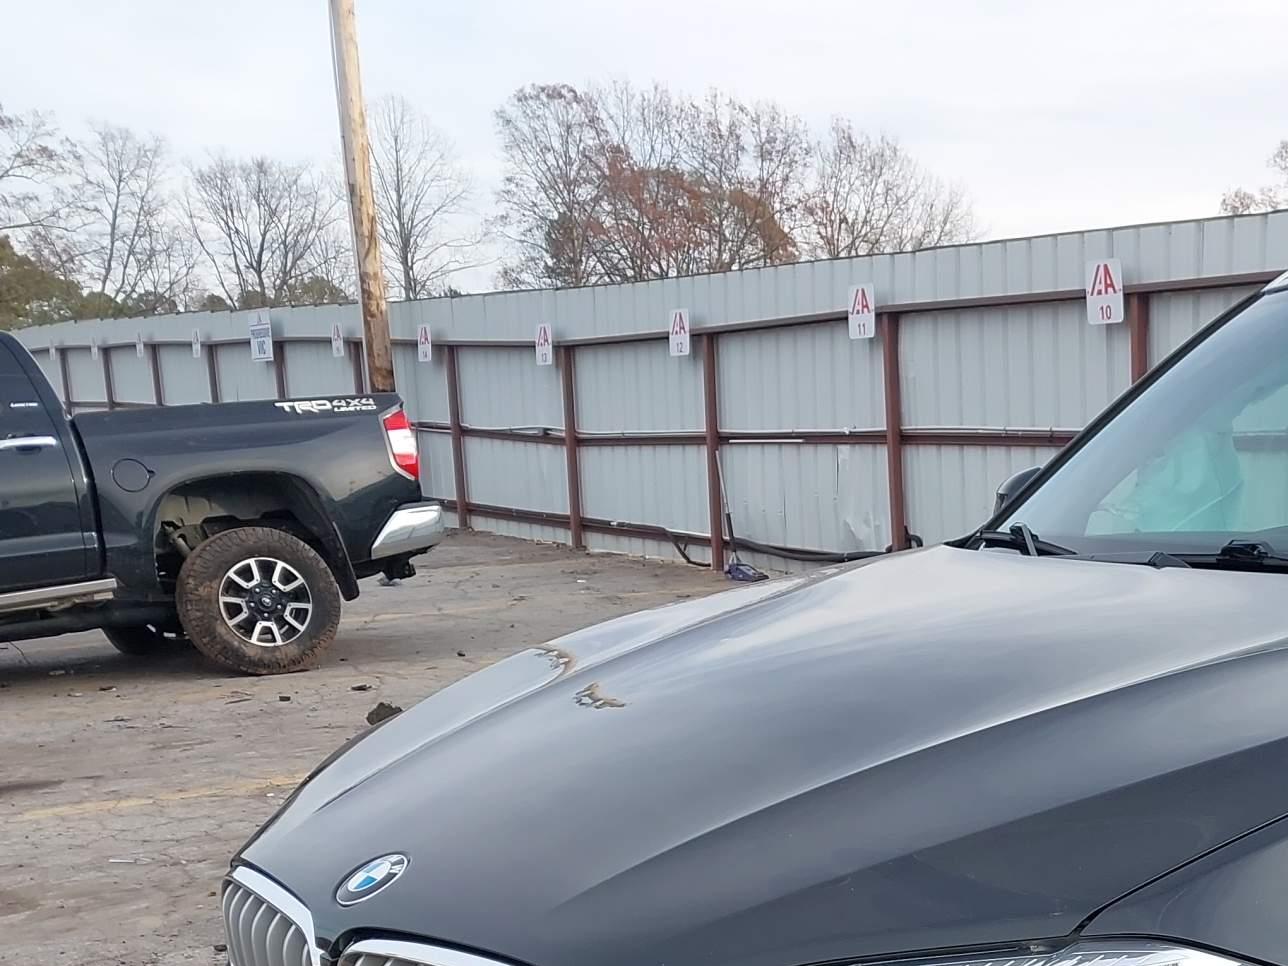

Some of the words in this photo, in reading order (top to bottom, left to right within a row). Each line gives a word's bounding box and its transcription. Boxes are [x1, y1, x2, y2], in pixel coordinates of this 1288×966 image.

[1098, 304, 1112, 321] 10
[857, 322, 866, 337] 11
[675, 342, 684, 353] 12
[274, 400, 333, 414] TRD
